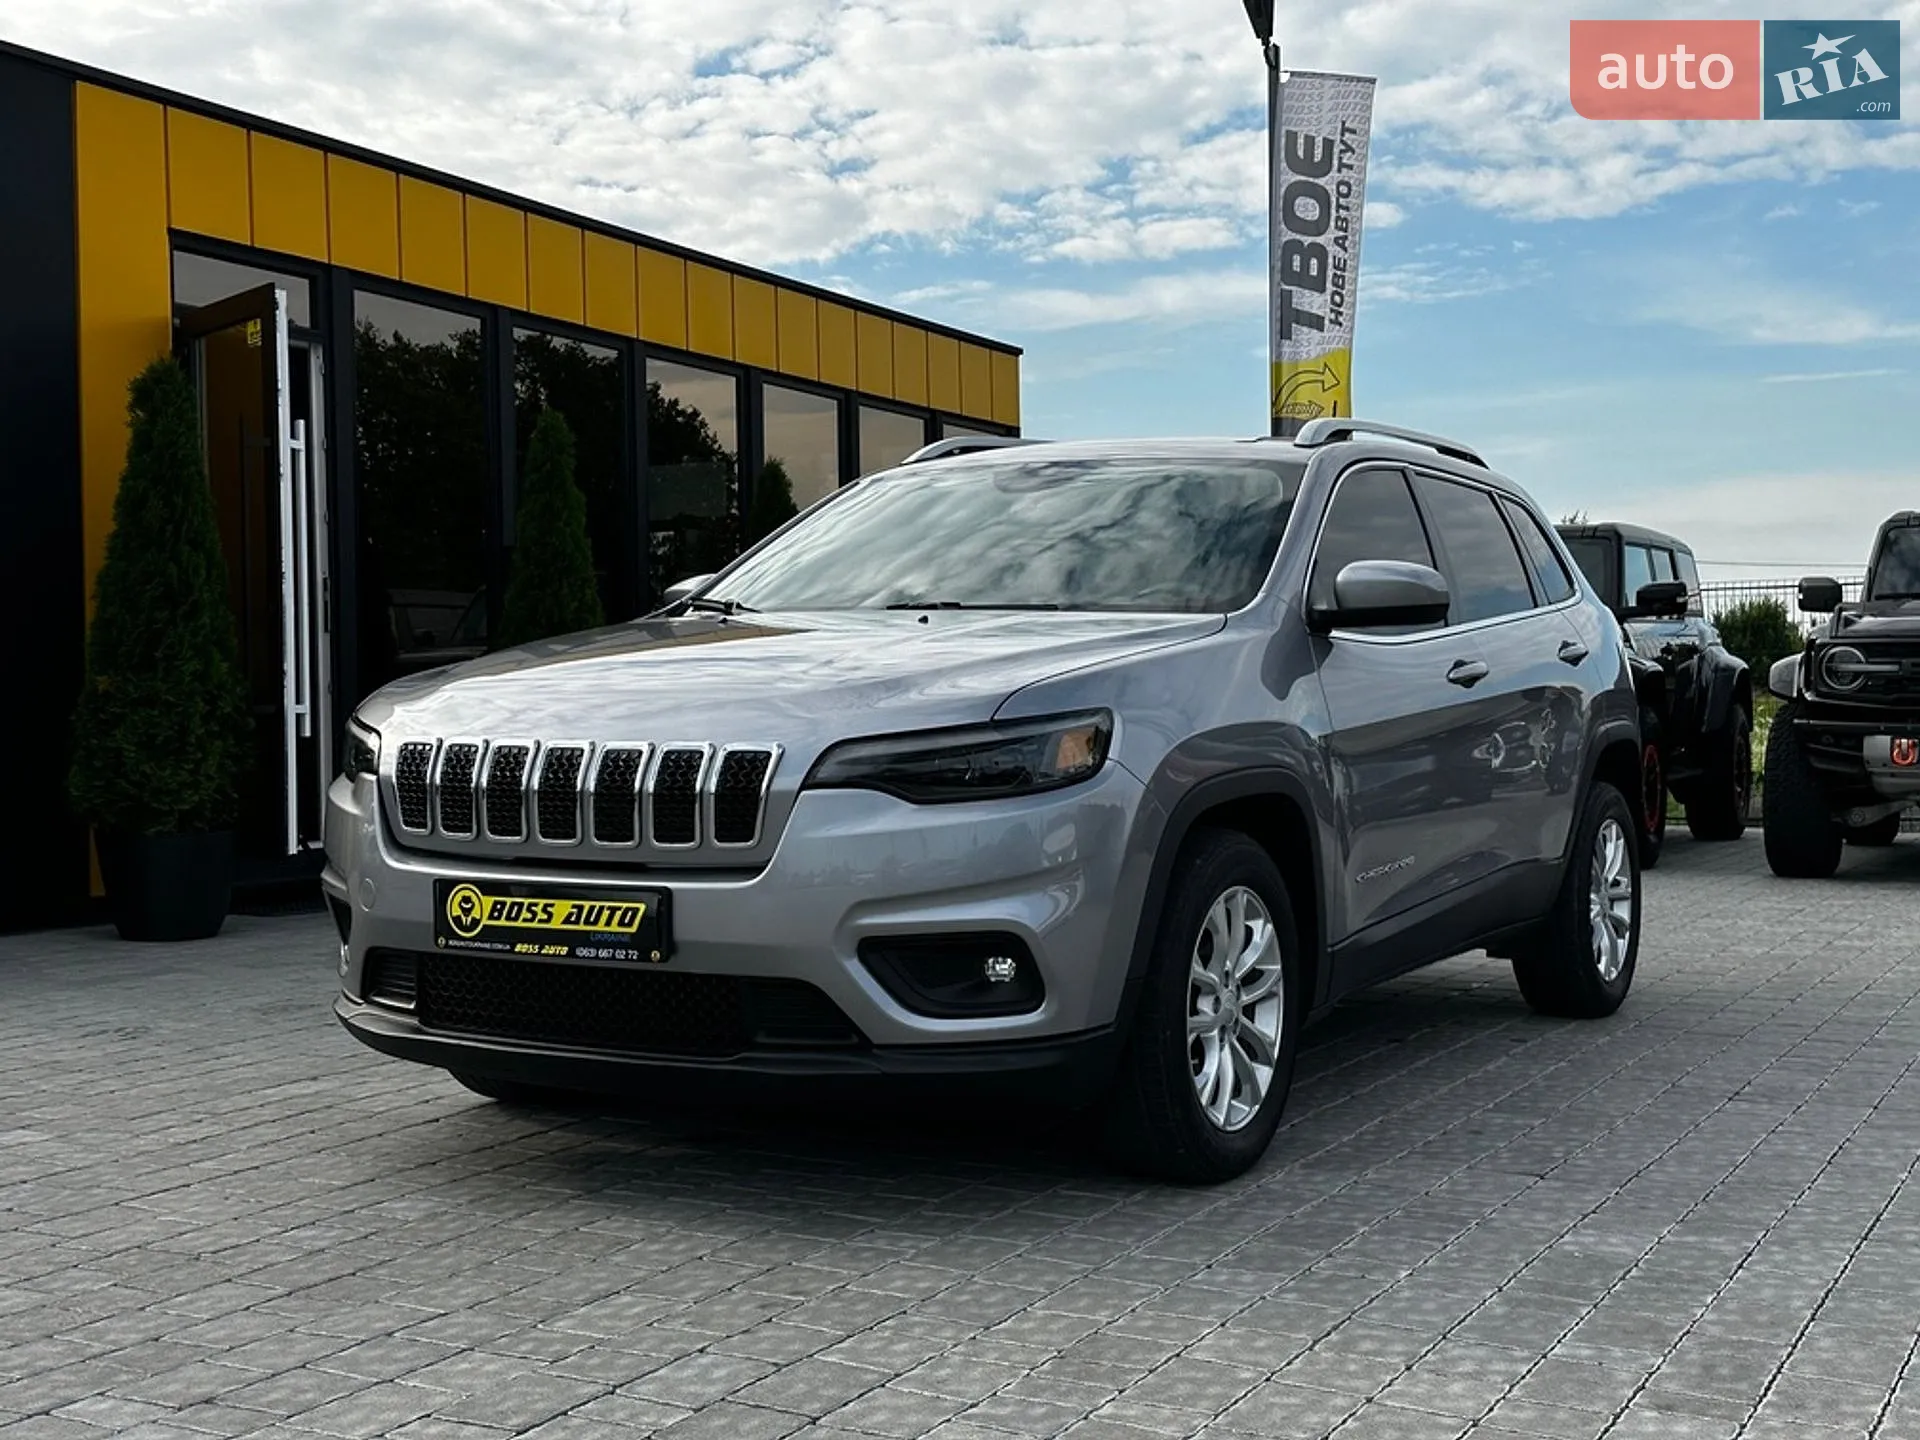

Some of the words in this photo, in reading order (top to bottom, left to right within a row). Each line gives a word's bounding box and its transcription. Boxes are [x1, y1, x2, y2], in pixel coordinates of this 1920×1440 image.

[1337, 120, 1358, 174] ТУТ
[1280, 129, 1335, 341] ТВОЄ
[1333, 179, 1352, 253] АВТО
[1329, 255, 1347, 328] НОВЕ
[487, 900, 555, 924] BOSS
[560, 904, 640, 928] AUTO
[514, 942, 540, 954] BOSS
[627, 949, 639, 960] 72
